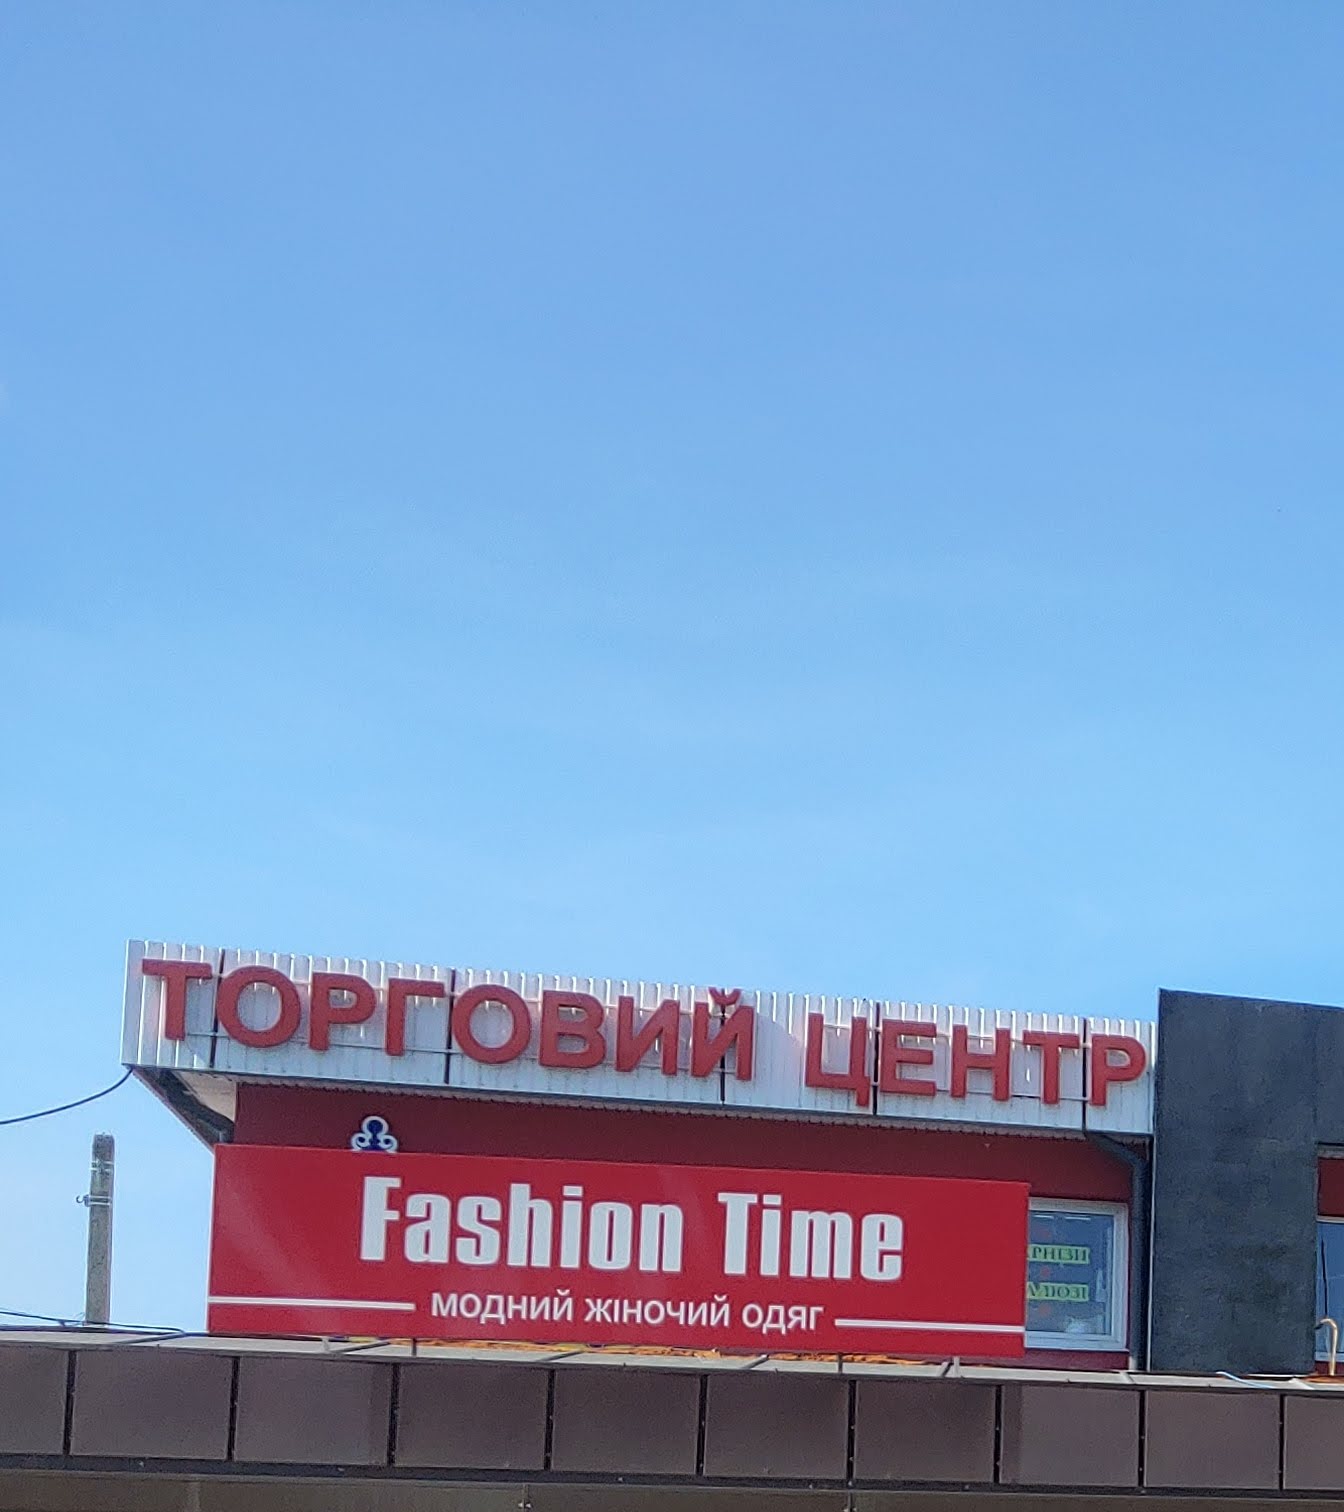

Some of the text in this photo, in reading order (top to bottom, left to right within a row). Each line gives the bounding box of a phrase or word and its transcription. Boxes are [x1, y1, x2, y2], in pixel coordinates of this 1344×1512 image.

[141, 958, 1149, 1107] ТОРГОВИЙ ЦЕНТР
[360, 1175, 904, 1282] Fashion Time
[431, 1289, 825, 1335] МОДНИЙ ЖІНОЧИЙ ОДЯГ
